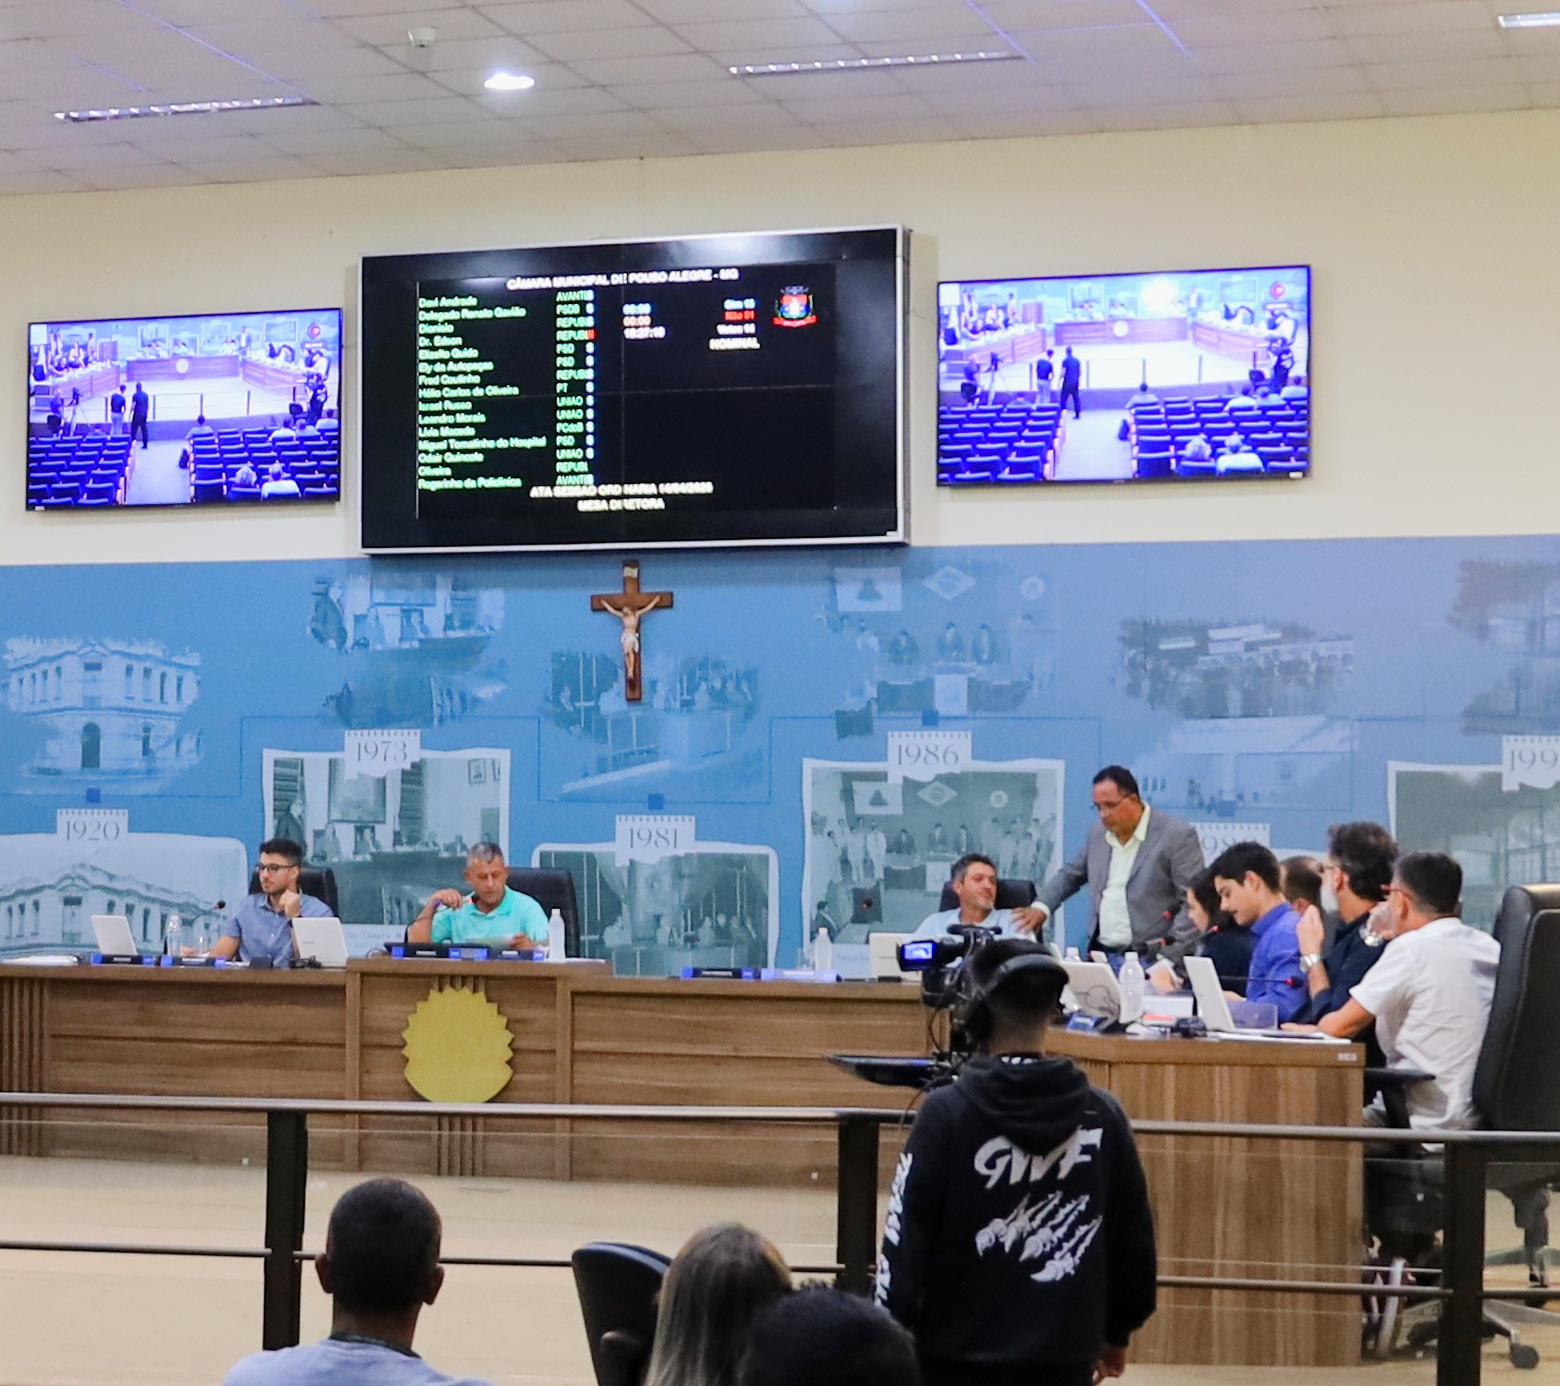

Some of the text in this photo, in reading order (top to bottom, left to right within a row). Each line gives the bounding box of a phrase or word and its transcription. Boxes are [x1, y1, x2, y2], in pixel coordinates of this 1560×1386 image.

[553, 274, 610, 288] MUNICIPAL
[629, 271, 668, 283] POUSO
[668, 269, 712, 282] ALEGRE
[556, 382, 568, 393] PT
[419, 413, 455, 425] Leandro
[530, 486, 553, 498] ATA
[577, 499, 609, 512] MESA
[357, 740, 408, 763] 1973
[897, 743, 960, 766] 1986
[65, 818, 120, 841] 1920
[629, 826, 678, 849] 1981
